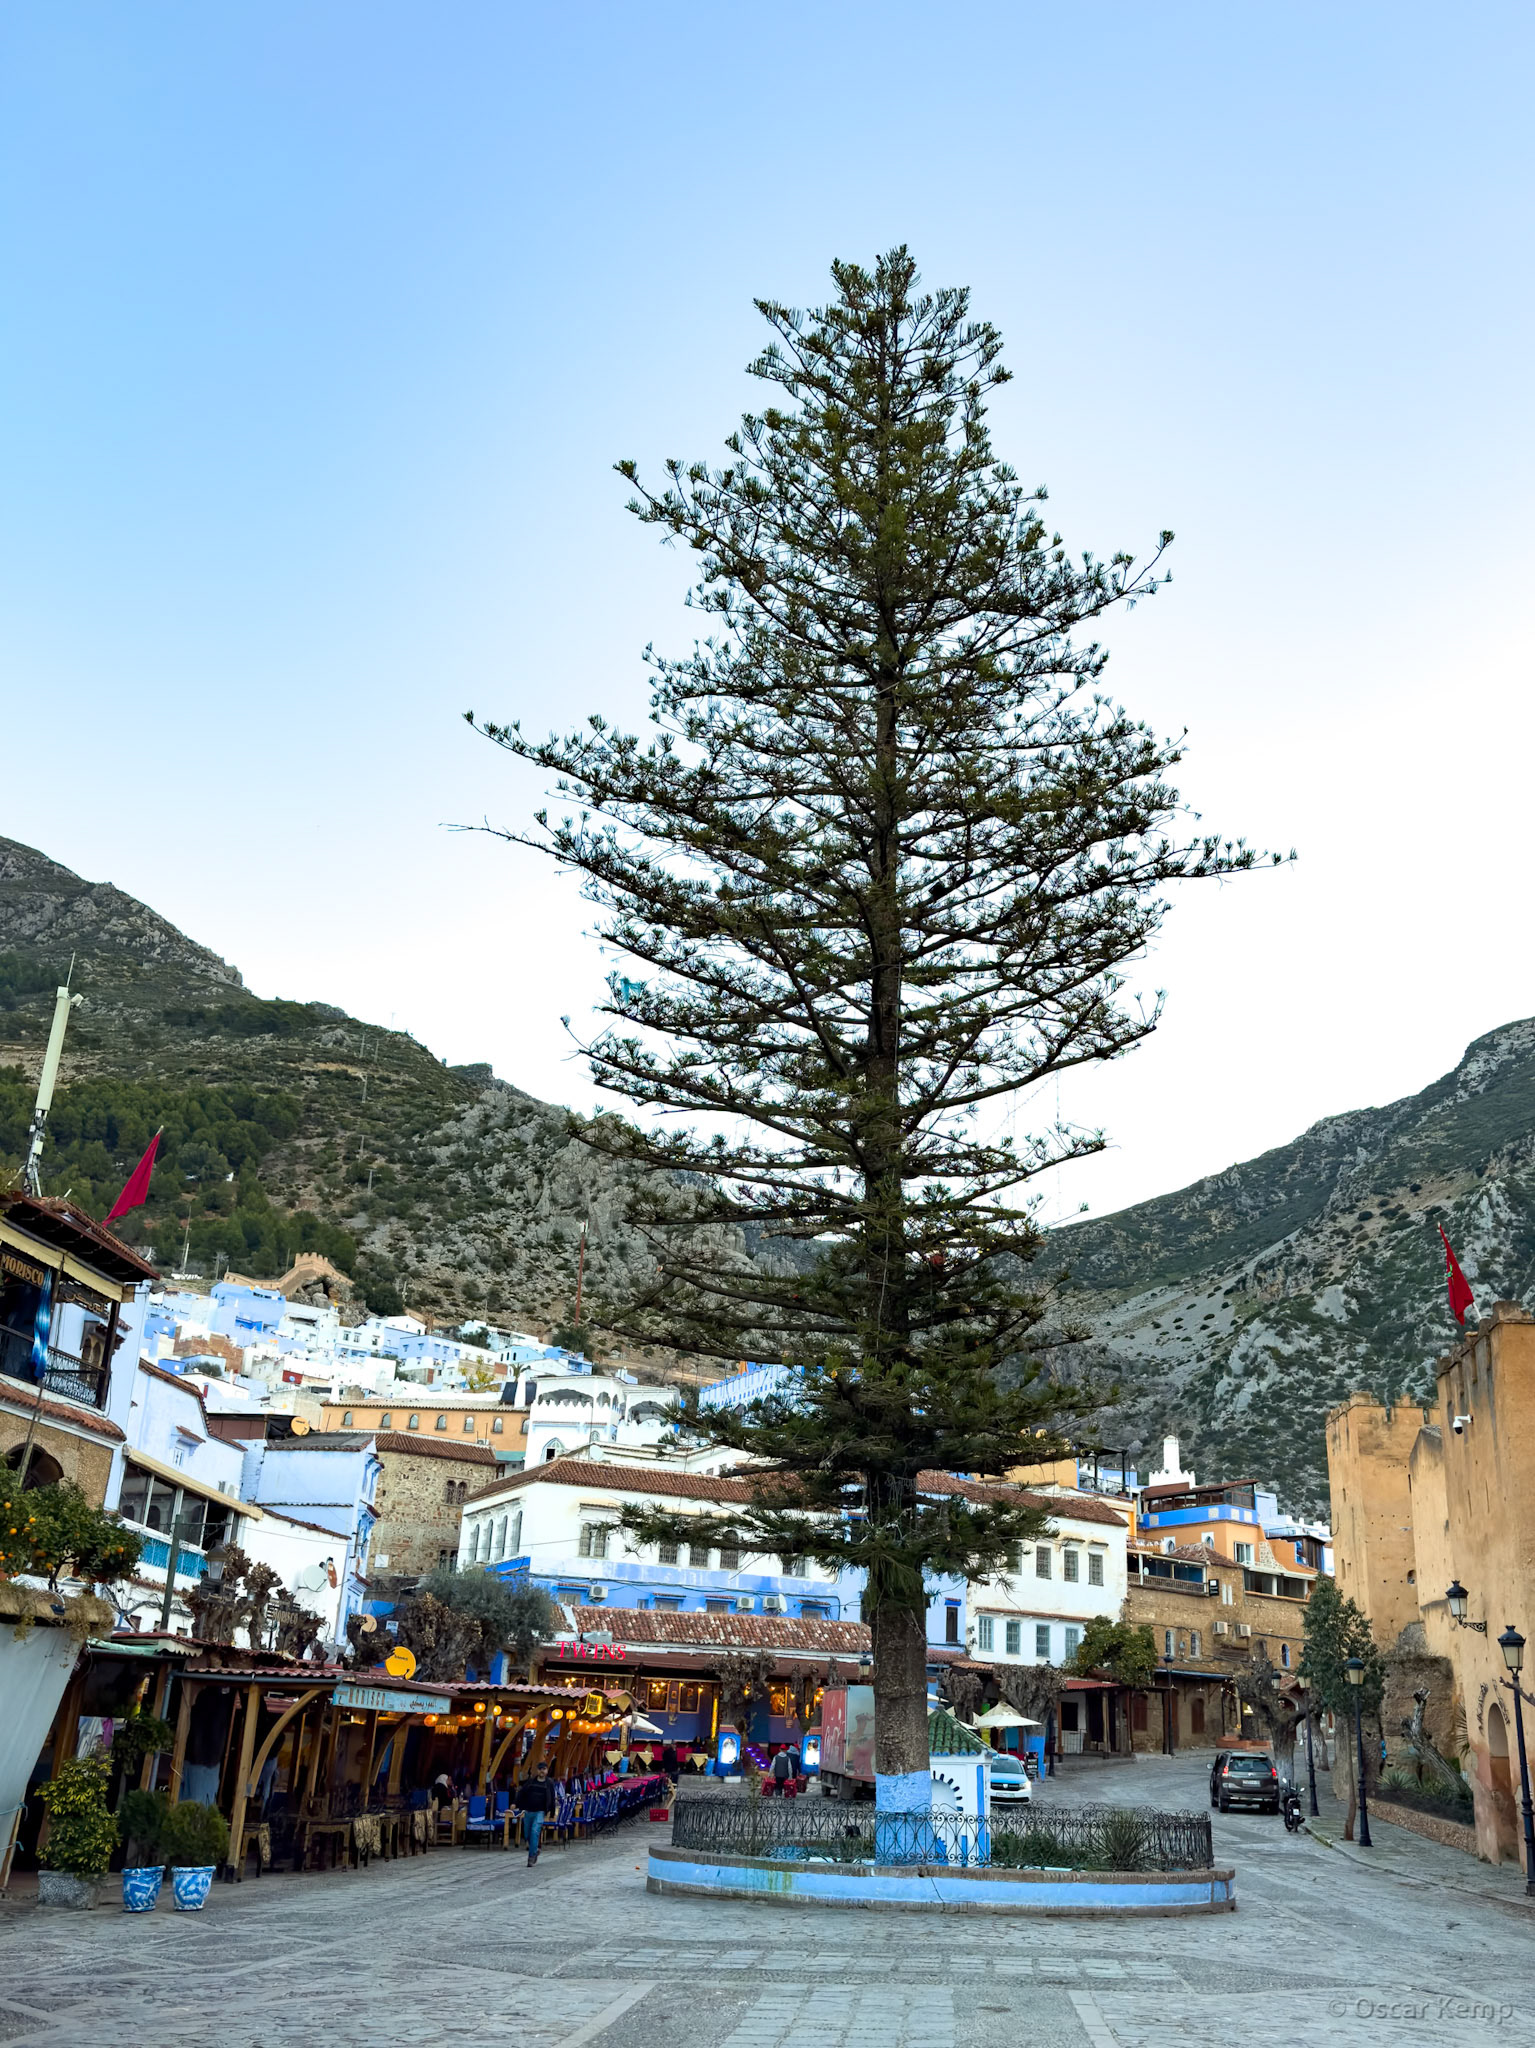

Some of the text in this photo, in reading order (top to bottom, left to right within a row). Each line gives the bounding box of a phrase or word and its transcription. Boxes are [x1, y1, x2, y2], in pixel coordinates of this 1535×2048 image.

[0, 1253, 45, 1286] MORISCO
[555, 1641, 627, 1661] TWINS
[348, 1687, 386, 1707] MORISCO
